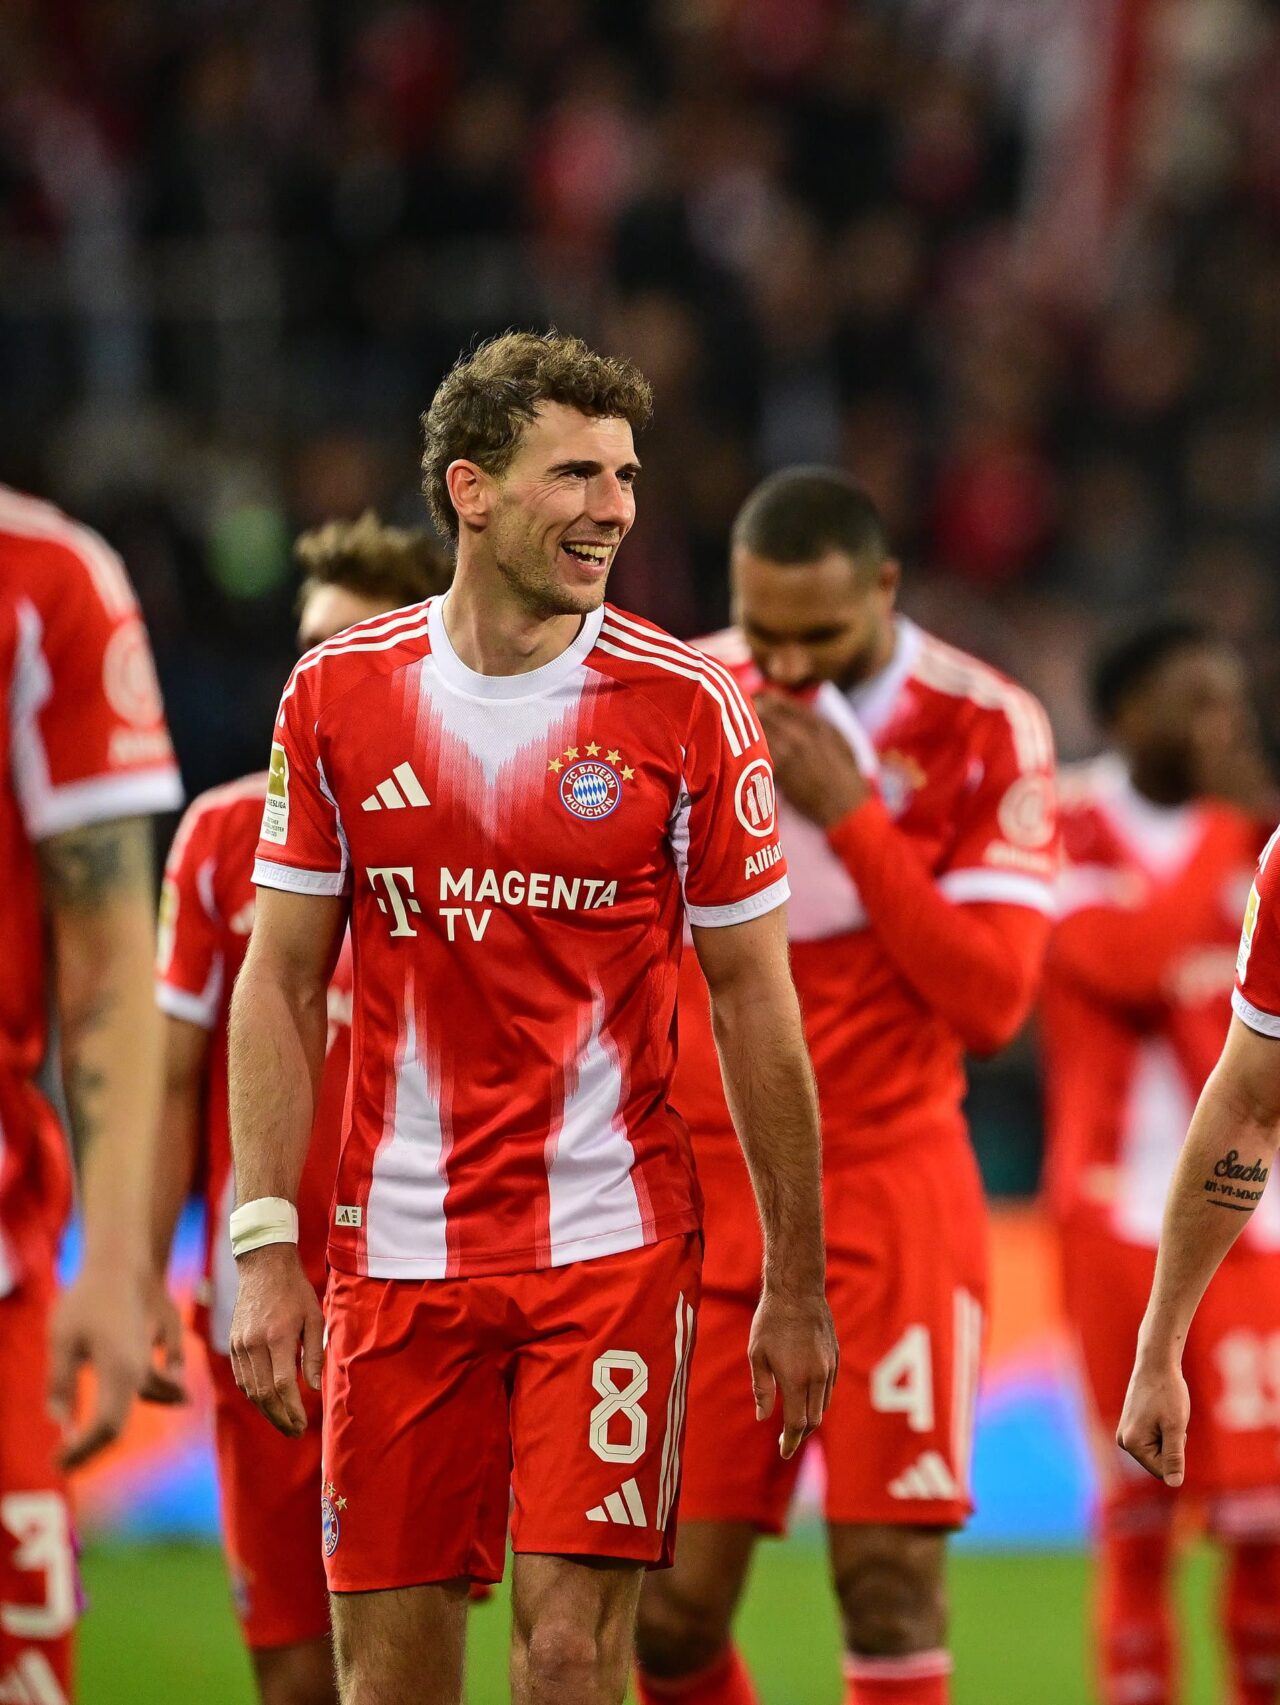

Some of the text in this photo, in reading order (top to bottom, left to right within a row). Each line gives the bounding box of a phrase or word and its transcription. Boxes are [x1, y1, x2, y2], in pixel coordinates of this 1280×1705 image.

[565, 765, 616, 789] FC BAYERN
[439, 867, 618, 911] MAGENTA
[439, 908, 492, 942] TV
[868, 1323, 935, 1433] 4
[588, 1349, 649, 1464] 8
